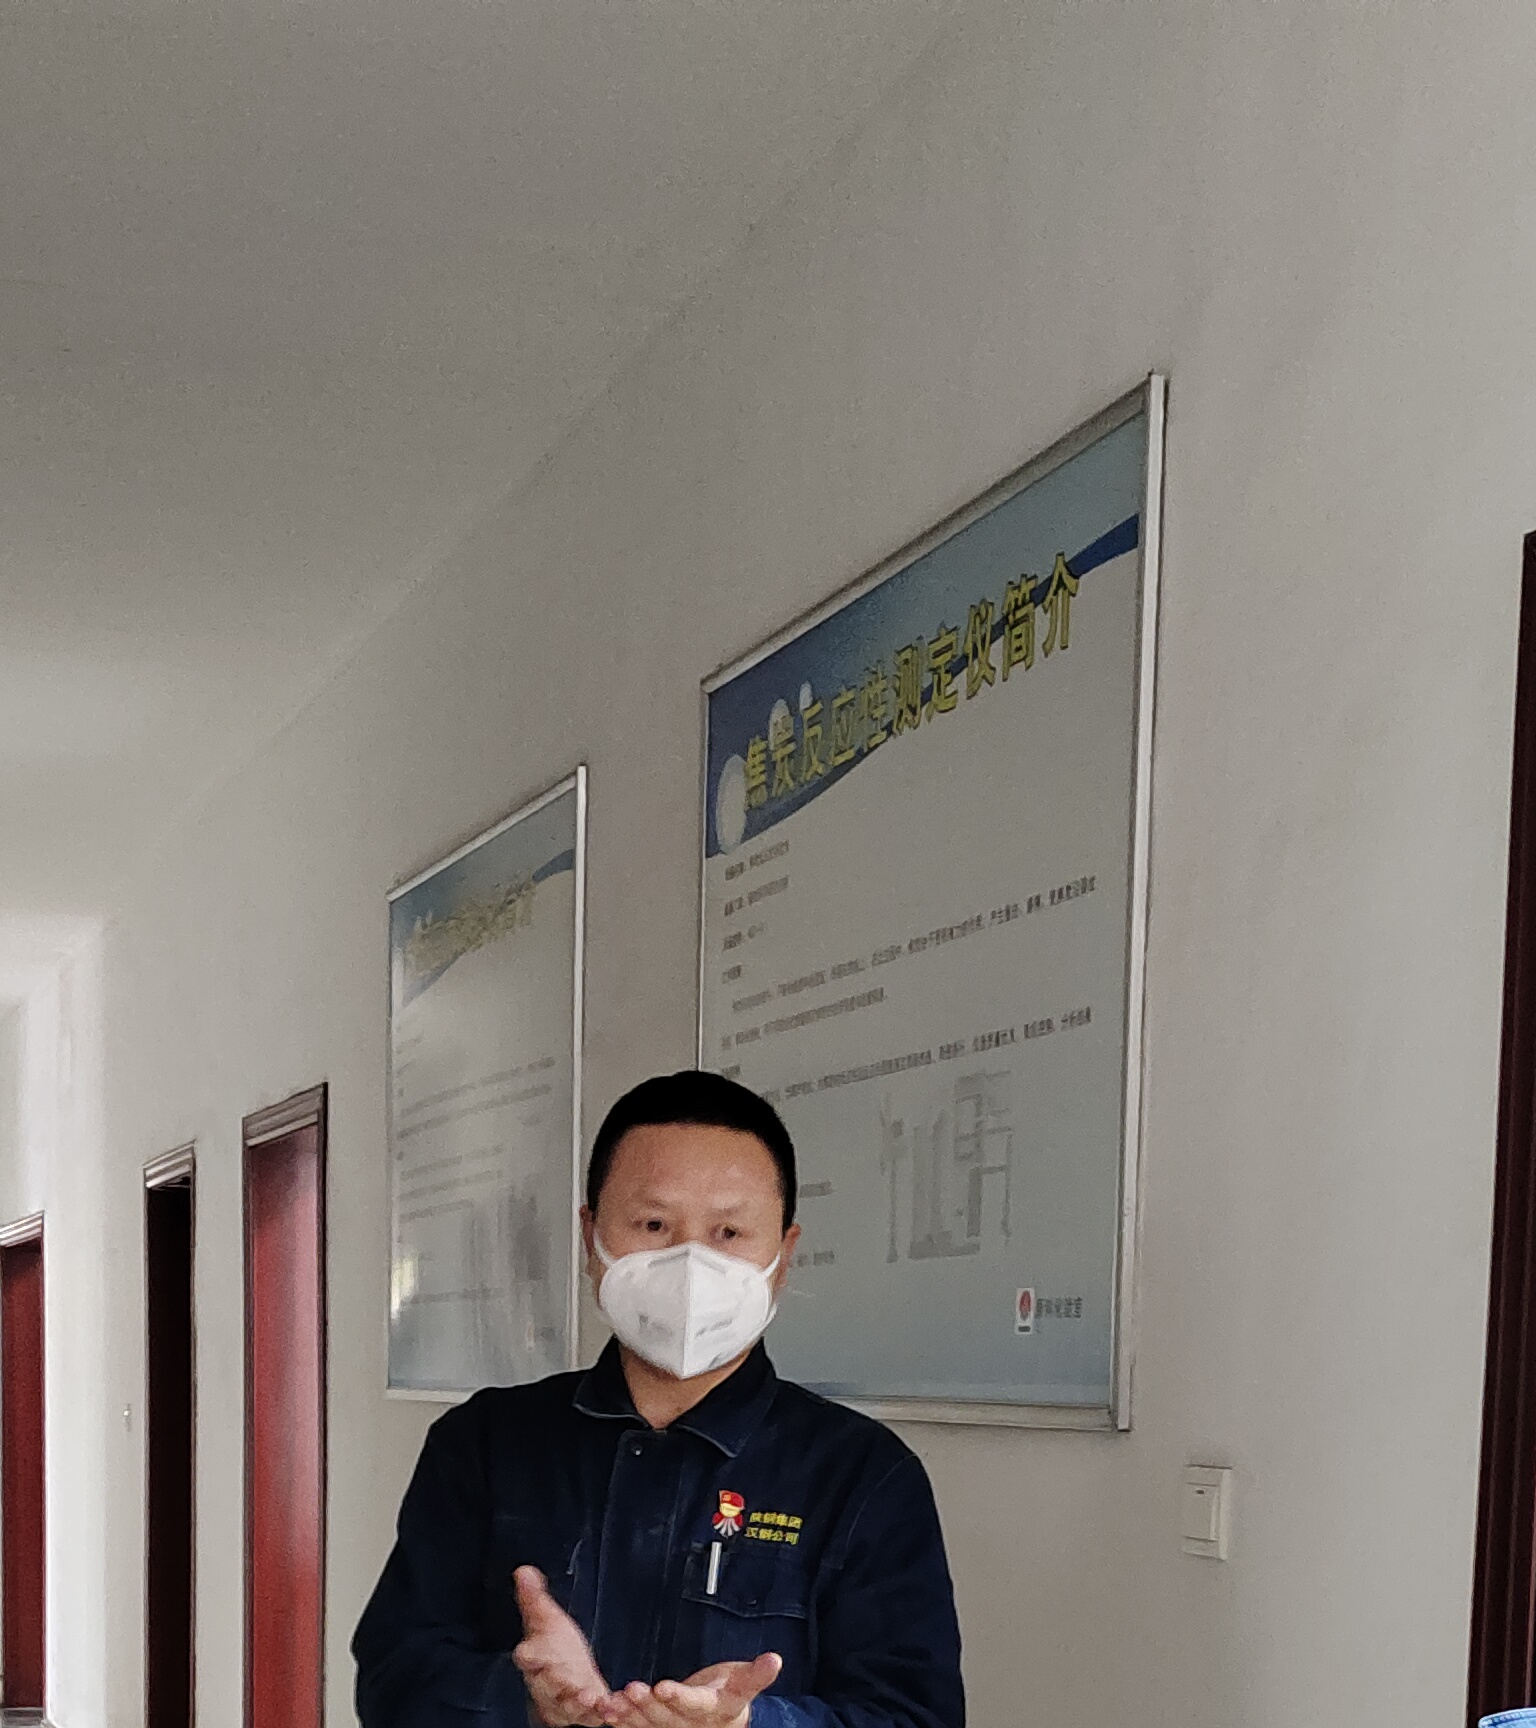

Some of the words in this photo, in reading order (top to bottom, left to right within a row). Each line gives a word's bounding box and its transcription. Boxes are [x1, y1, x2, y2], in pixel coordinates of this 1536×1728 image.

[743, 551, 1079, 811] 焦炭反应性测定仪简介
